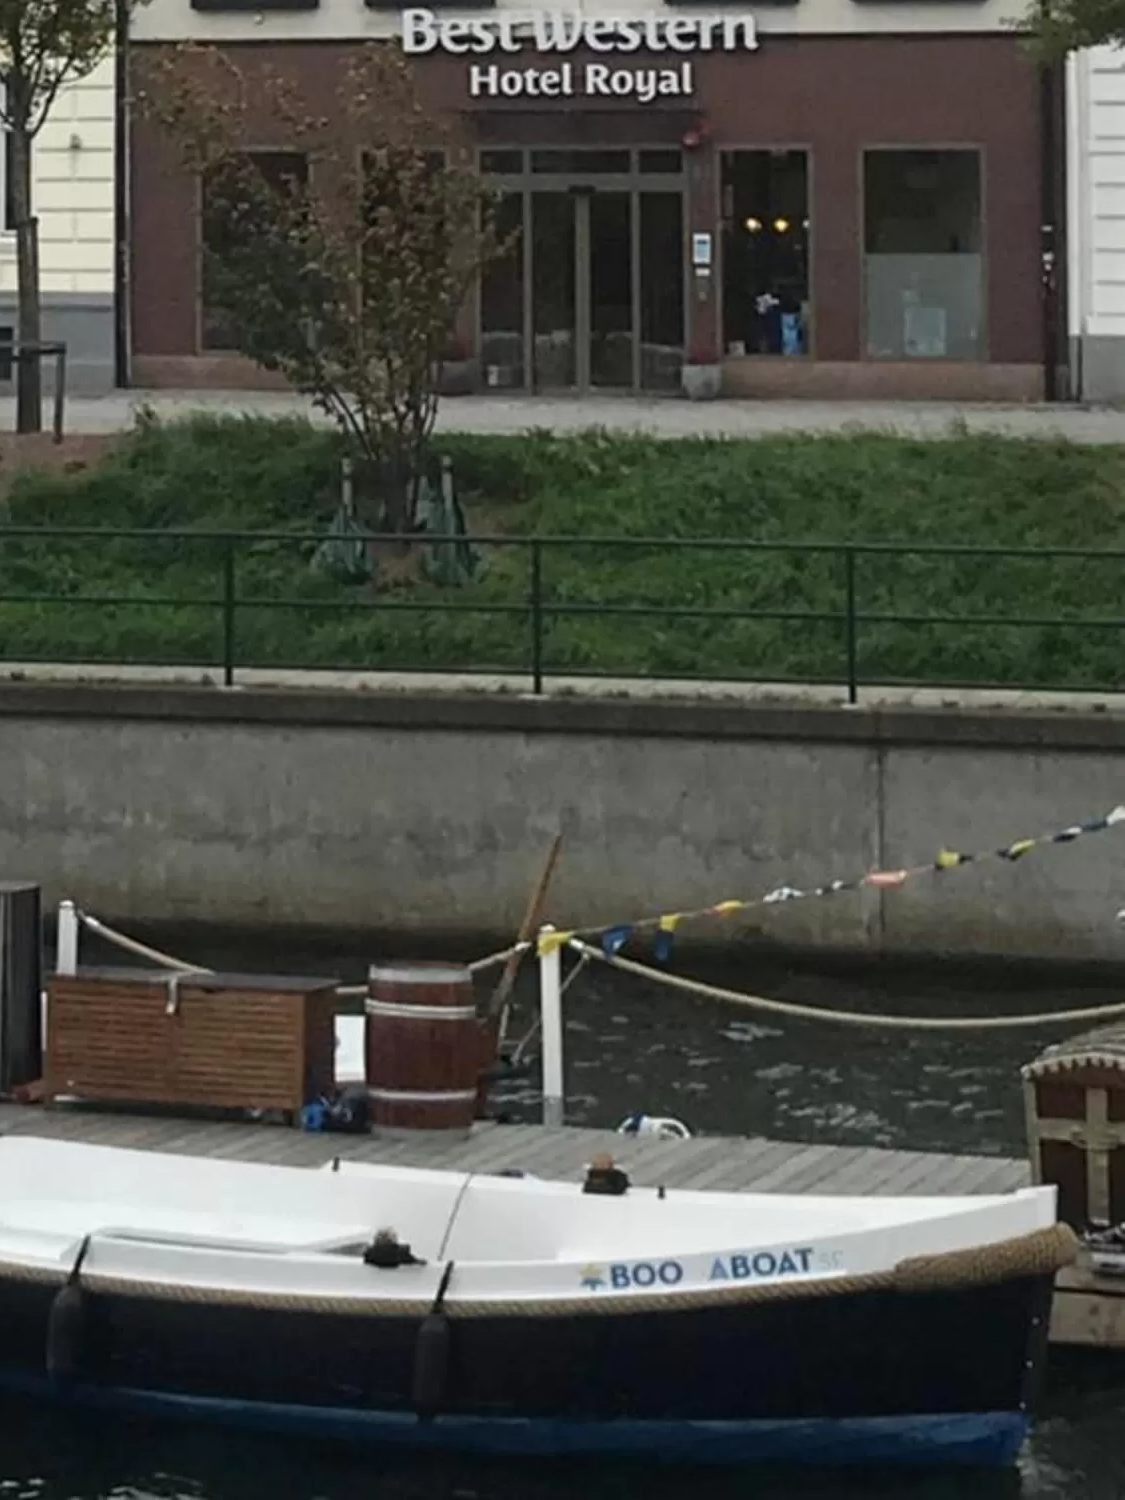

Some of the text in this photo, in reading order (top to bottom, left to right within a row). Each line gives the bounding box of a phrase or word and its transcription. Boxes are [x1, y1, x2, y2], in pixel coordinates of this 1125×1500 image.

[400, 7, 759, 54] Best Western
[469, 62, 693, 101] Hotel Royal
